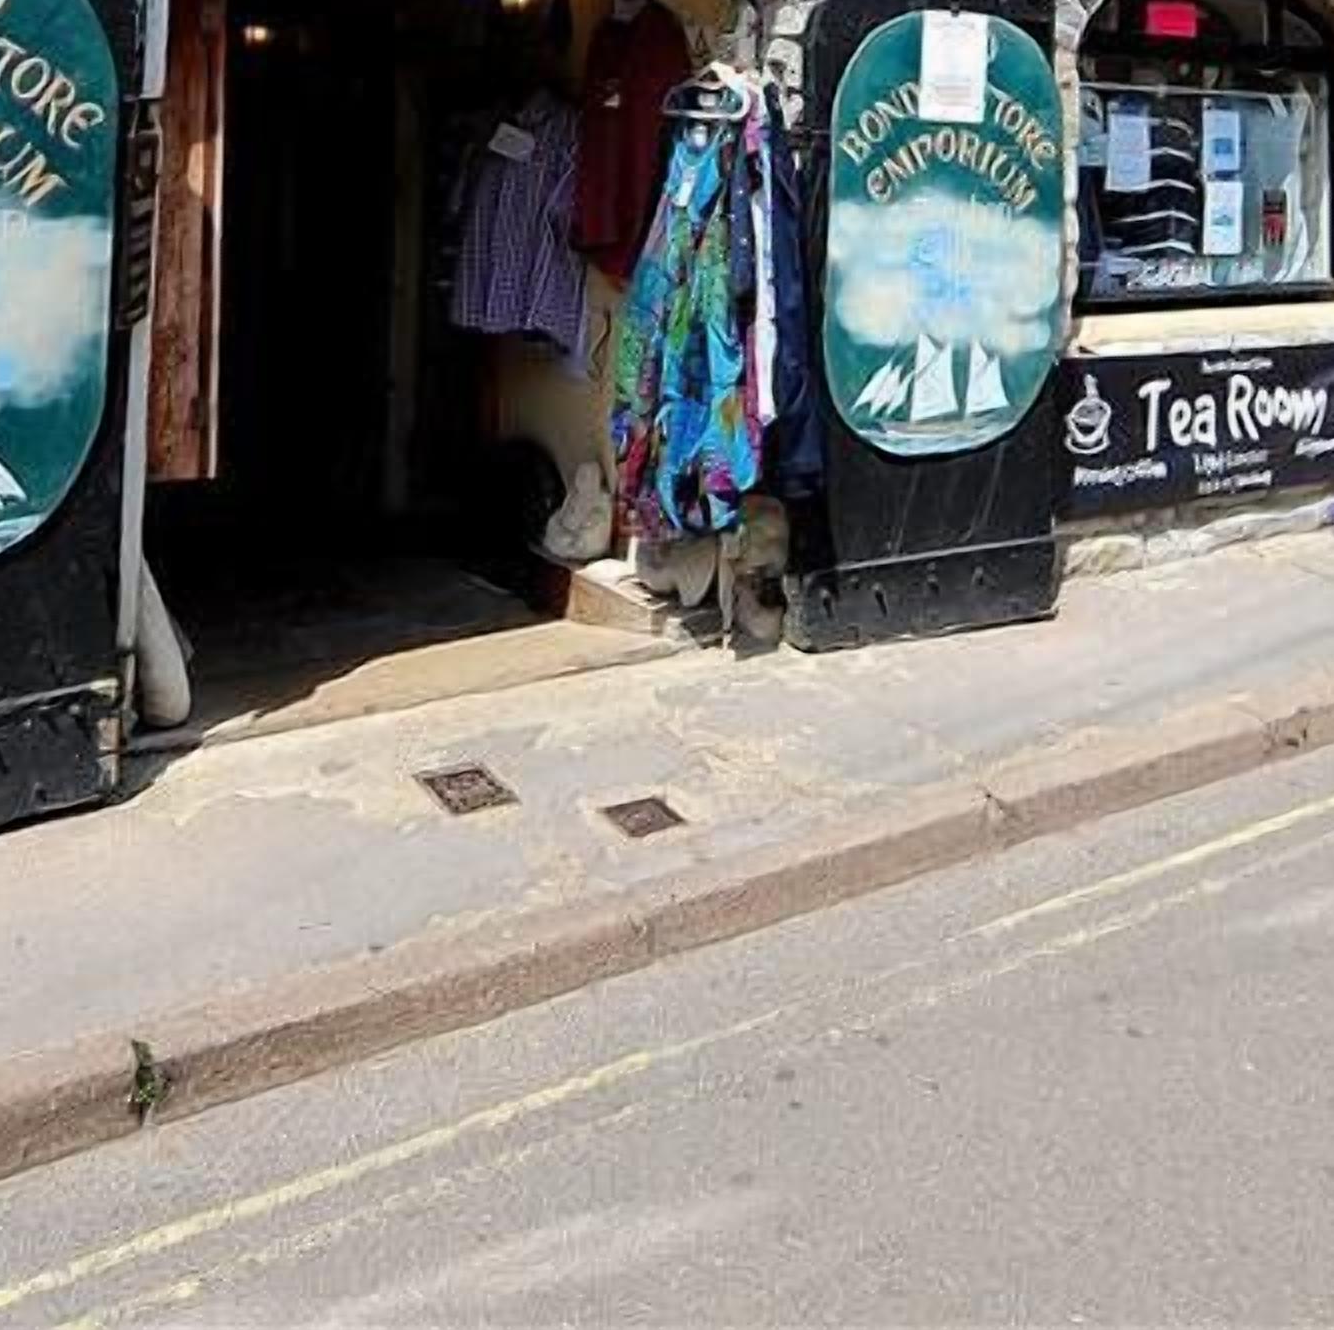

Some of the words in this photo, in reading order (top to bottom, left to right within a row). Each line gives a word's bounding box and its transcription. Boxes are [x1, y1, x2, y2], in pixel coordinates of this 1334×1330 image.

[866, 126, 1038, 211] EMPORIUM
[1138, 377, 1217, 452] Tea
[1227, 373, 1328, 442] Room
